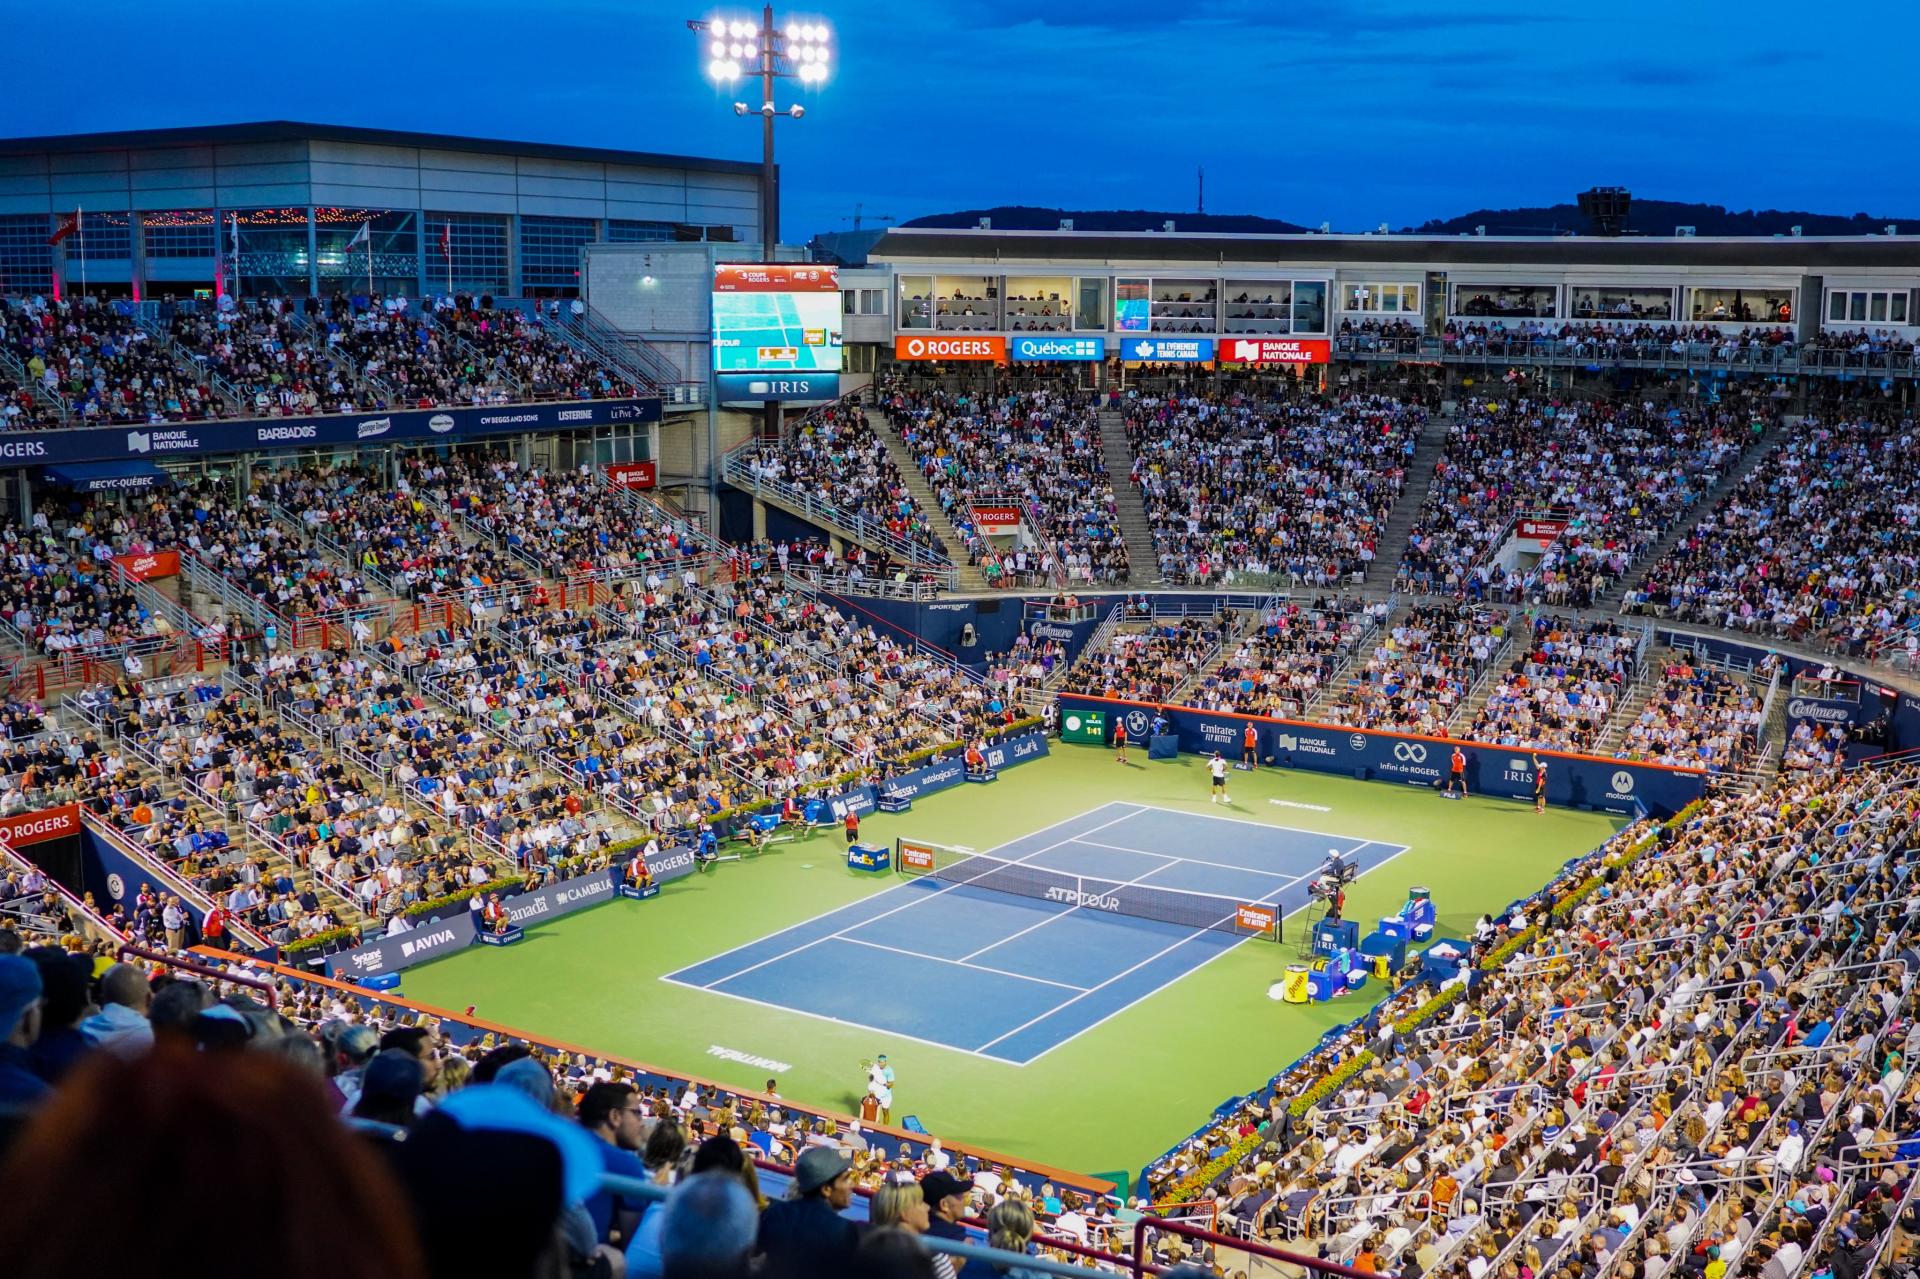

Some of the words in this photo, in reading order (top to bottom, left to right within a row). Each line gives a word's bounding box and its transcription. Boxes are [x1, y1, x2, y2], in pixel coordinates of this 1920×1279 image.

[928, 341, 991, 355] ROGERS
[1021, 341, 1075, 357] Québec
[1262, 342, 1299, 351] BANQUE
[1156, 350, 1176, 358] TENNIS
[1176, 350, 1199, 358] CANADA
[1262, 351, 1312, 360] NATIONALE
[770, 381, 809, 393] IRIS
[480, 417, 491, 425] CW
[491, 416, 509, 424] BEGGS
[510, 414, 522, 422] AND
[523, 414, 538, 422] SONS
[558, 410, 593, 421] LISTERINE
[152, 431, 188, 441] BANQUE
[257, 426, 317, 441] BARBADOS
[0, 441, 45, 457] GERS
[153, 439, 199, 450] NATIONALE
[89, 476, 154, 489] RECYC-QUÉBEC
[1788, 700, 1849, 720] Cashmere
[1200, 723, 1237, 736] Emirates
[1299, 737, 1327, 747] BANQUE
[1299, 745, 1336, 756] NATIONALE
[987, 749, 1004, 767] IGA
[1380, 762, 1398, 771] Infini
[1399, 764, 1409, 773] de
[1410, 766, 1440, 776] ROGERS
[921, 769, 951, 785] autologica
[1503, 770, 1533, 783] IRIS
[1605, 792, 1635, 801] motorol
[14, 814, 70, 839] ROGERS
[849, 851, 874, 866] FedEx
[904, 848, 932, 860] Emirates
[650, 852, 690, 875] ROGERS
[568, 878, 614, 901] CAMBRIA
[1045, 886, 1078, 904] ATP
[1079, 892, 1120, 912] TOUR
[503, 895, 549, 922] Canada
[1239, 908, 1272, 922] Emirates
[415, 929, 455, 952] AVIVA
[1317, 941, 1338, 950] IRIS
[352, 949, 382, 969] Systane
